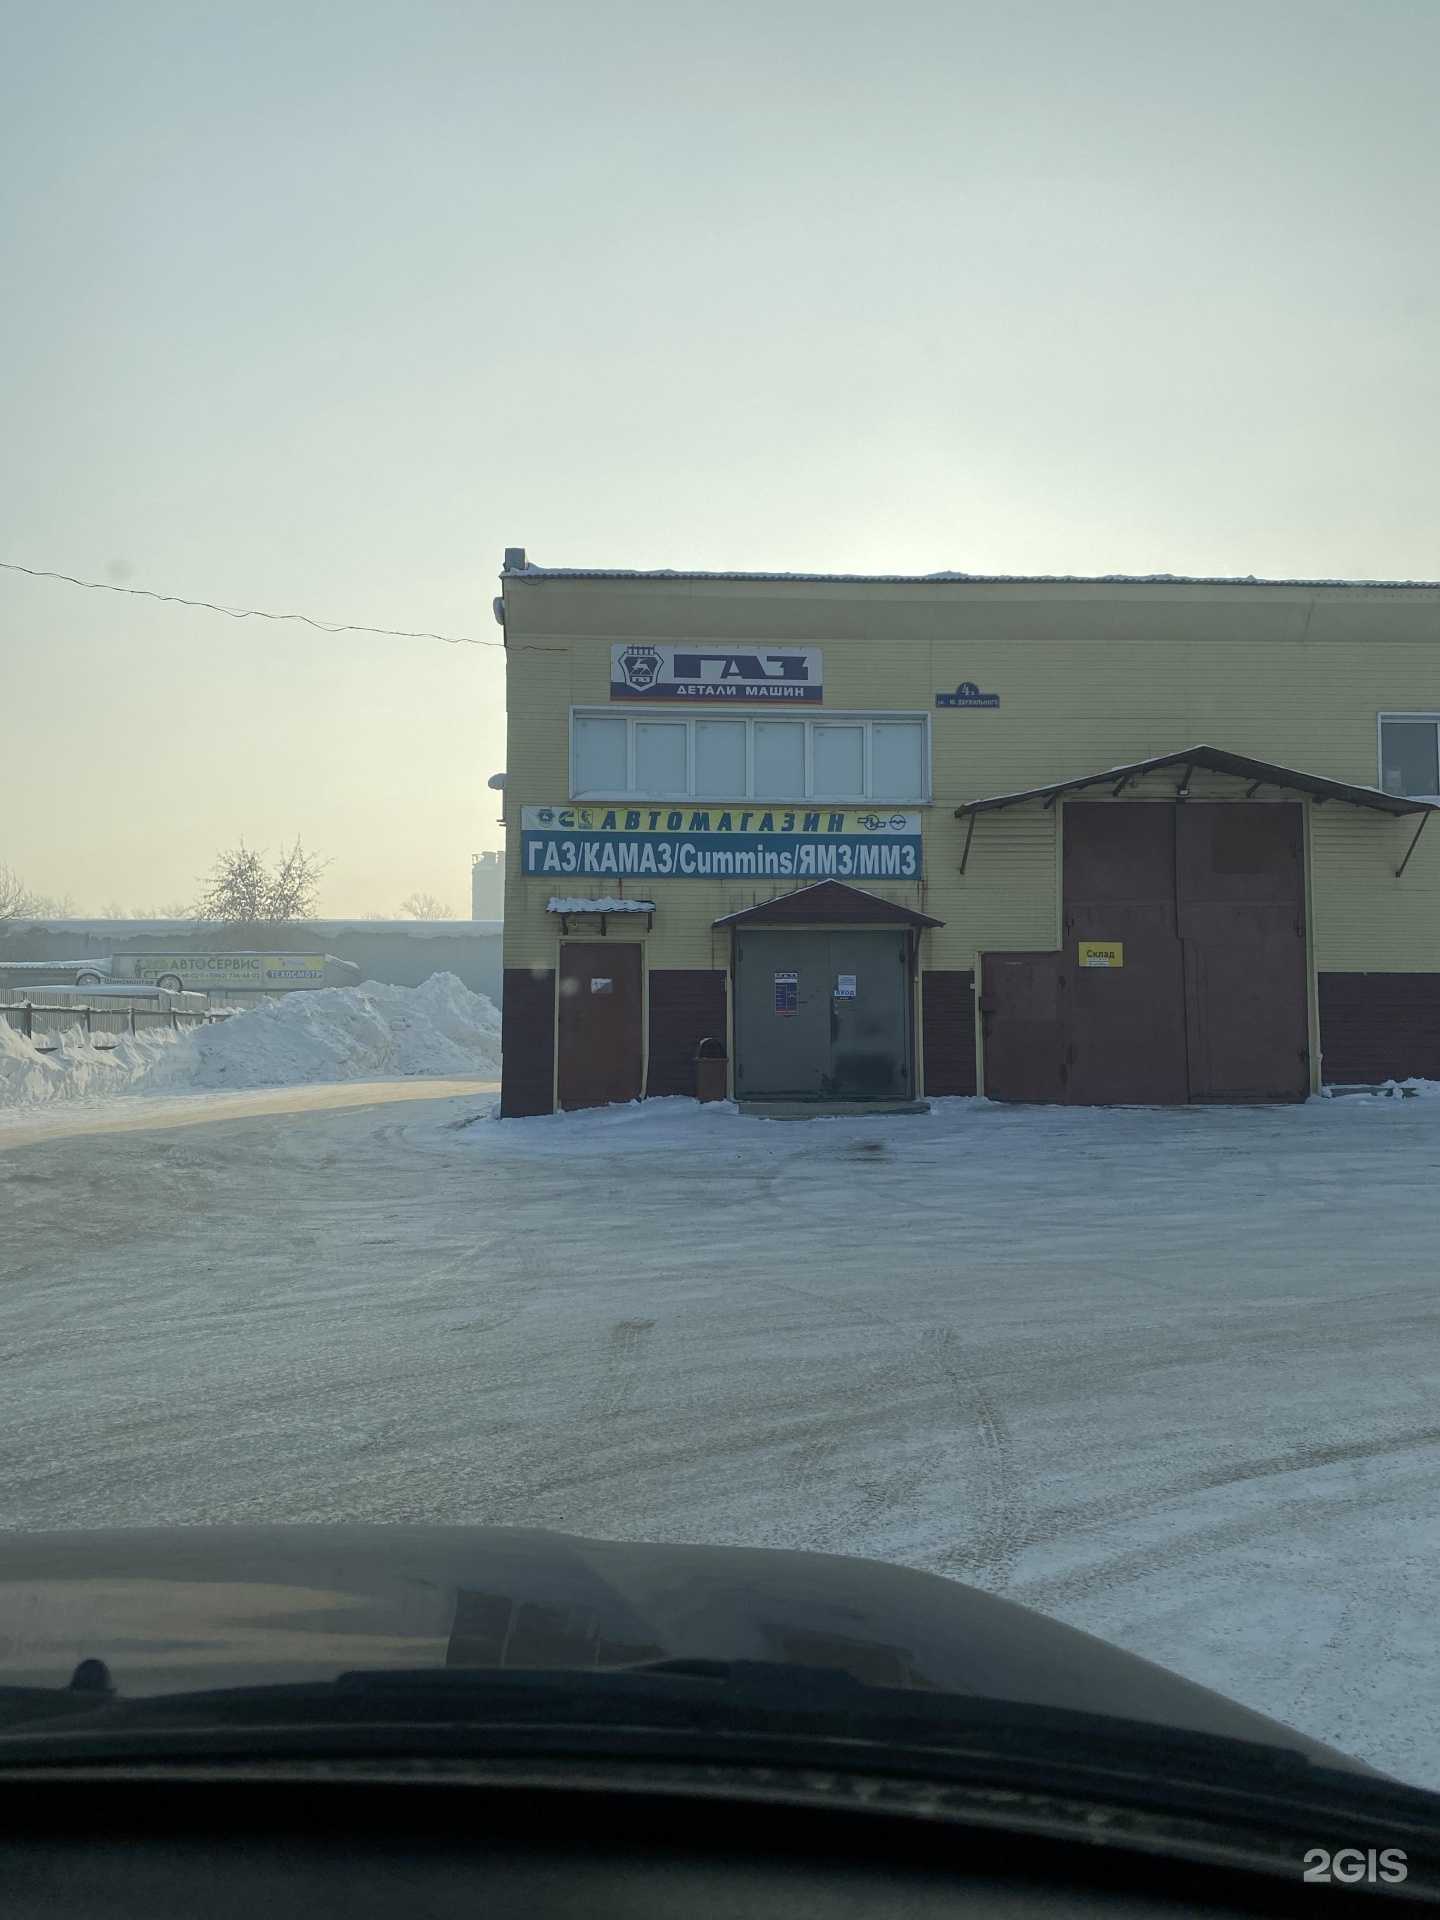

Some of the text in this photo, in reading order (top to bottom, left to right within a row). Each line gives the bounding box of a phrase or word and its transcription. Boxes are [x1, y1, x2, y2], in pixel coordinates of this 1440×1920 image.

[673, 654, 809, 681] ГАЗ
[676, 685, 805, 697] ДЕТАЛИ МАШИН
[601, 811, 847, 833] АВТОМАГАЗИН
[1086, 949, 1115, 959] Склад
[170, 958, 260, 971] АВТОСЕРВИС
